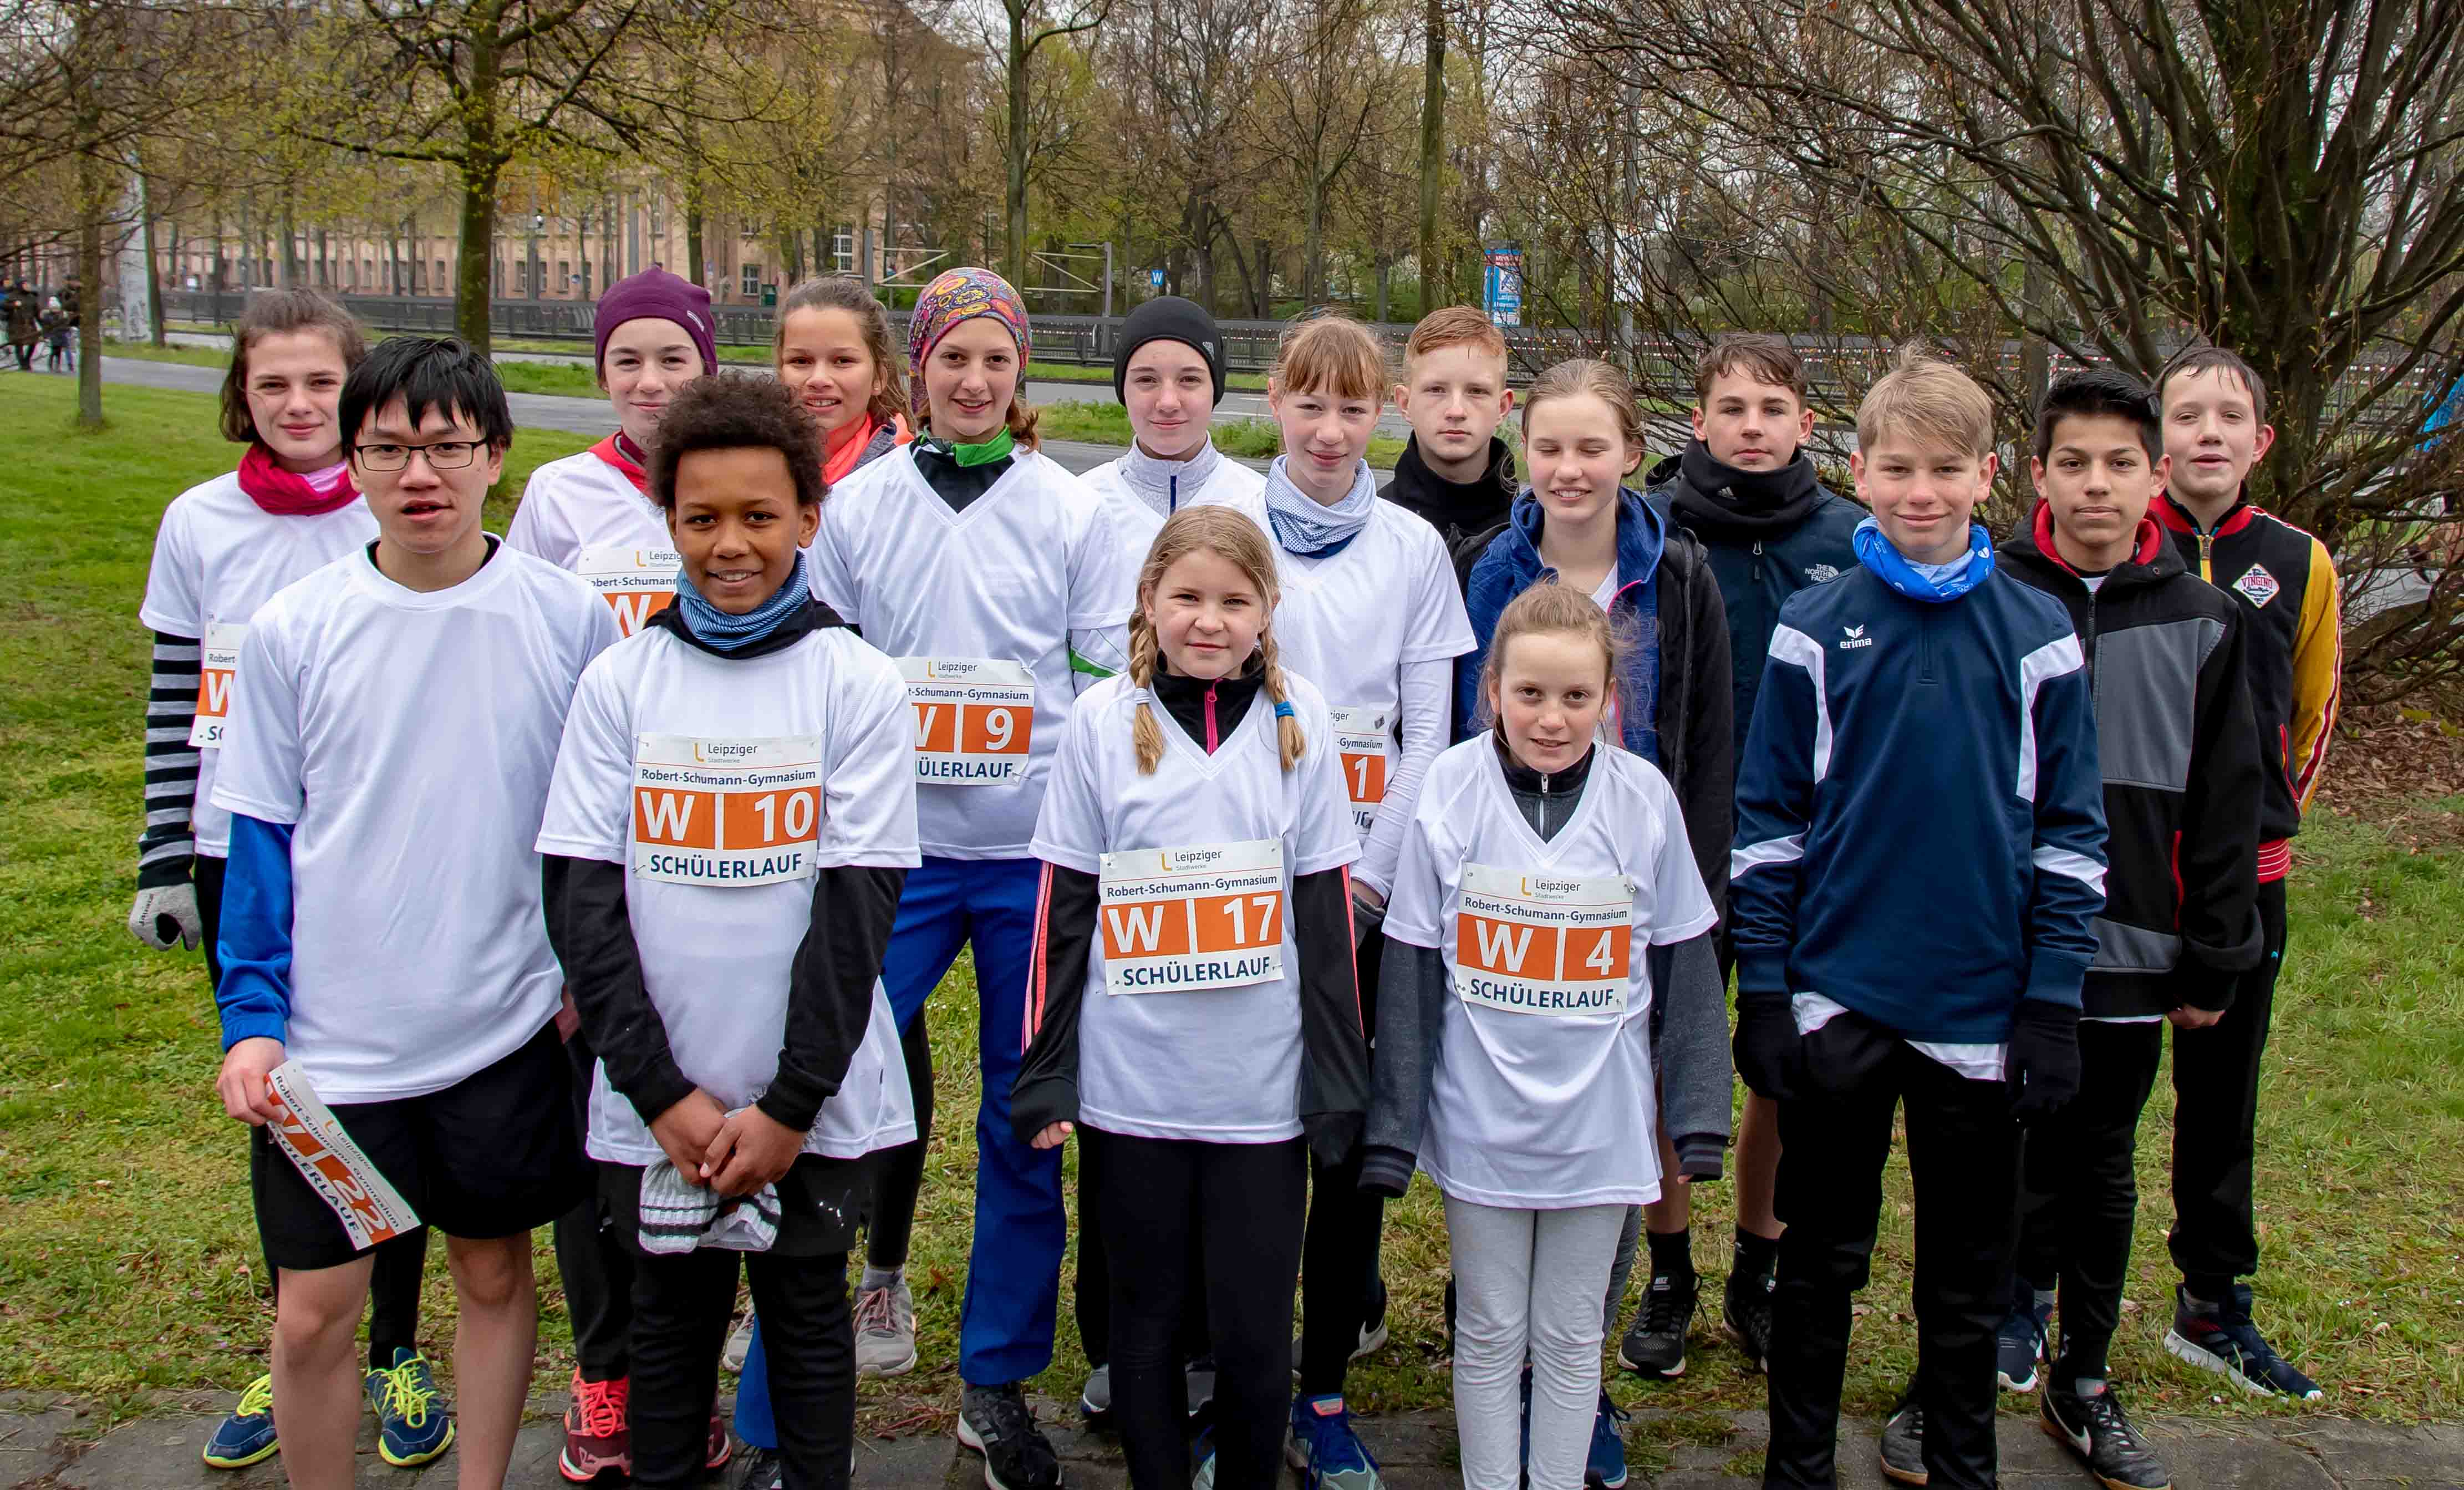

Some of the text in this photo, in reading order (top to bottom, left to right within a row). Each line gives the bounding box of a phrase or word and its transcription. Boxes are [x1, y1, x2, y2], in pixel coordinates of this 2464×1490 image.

[1153, 272, 1163, 283] W
[1805, 567, 1828, 577] NORTH
[2241, 576, 2273, 589] VINGINO
[1840, 638, 1872, 649] erima
[938, 661, 978, 673] Leipziger
[985, 708, 1014, 750] 9
[707, 743, 758, 756] Leipziger
[642, 769, 816, 786] Robert-Schumann-Gymnasium
[915, 756, 1014, 778] ÜLERLAUF
[1355, 756, 1368, 799] 1
[639, 791, 814, 842] W 10
[650, 853, 802, 878] SCHÜLERLAUF
[1175, 850, 1222, 863] Leipziger
[1107, 874, 1277, 898] Robert-Schumann-Gymnasium
[1535, 878, 1581, 893] Leipziger
[1465, 897, 1627, 923] Robert-Schumann-Gymnasium
[1107, 895, 1277, 954] W 17
[1475, 919, 1614, 976] W 4
[1123, 957, 1270, 986] SCHÜLERLAUF
[1470, 978, 1615, 1008] SCHÜLERLAUF
[333, 1175, 387, 1233] 22
